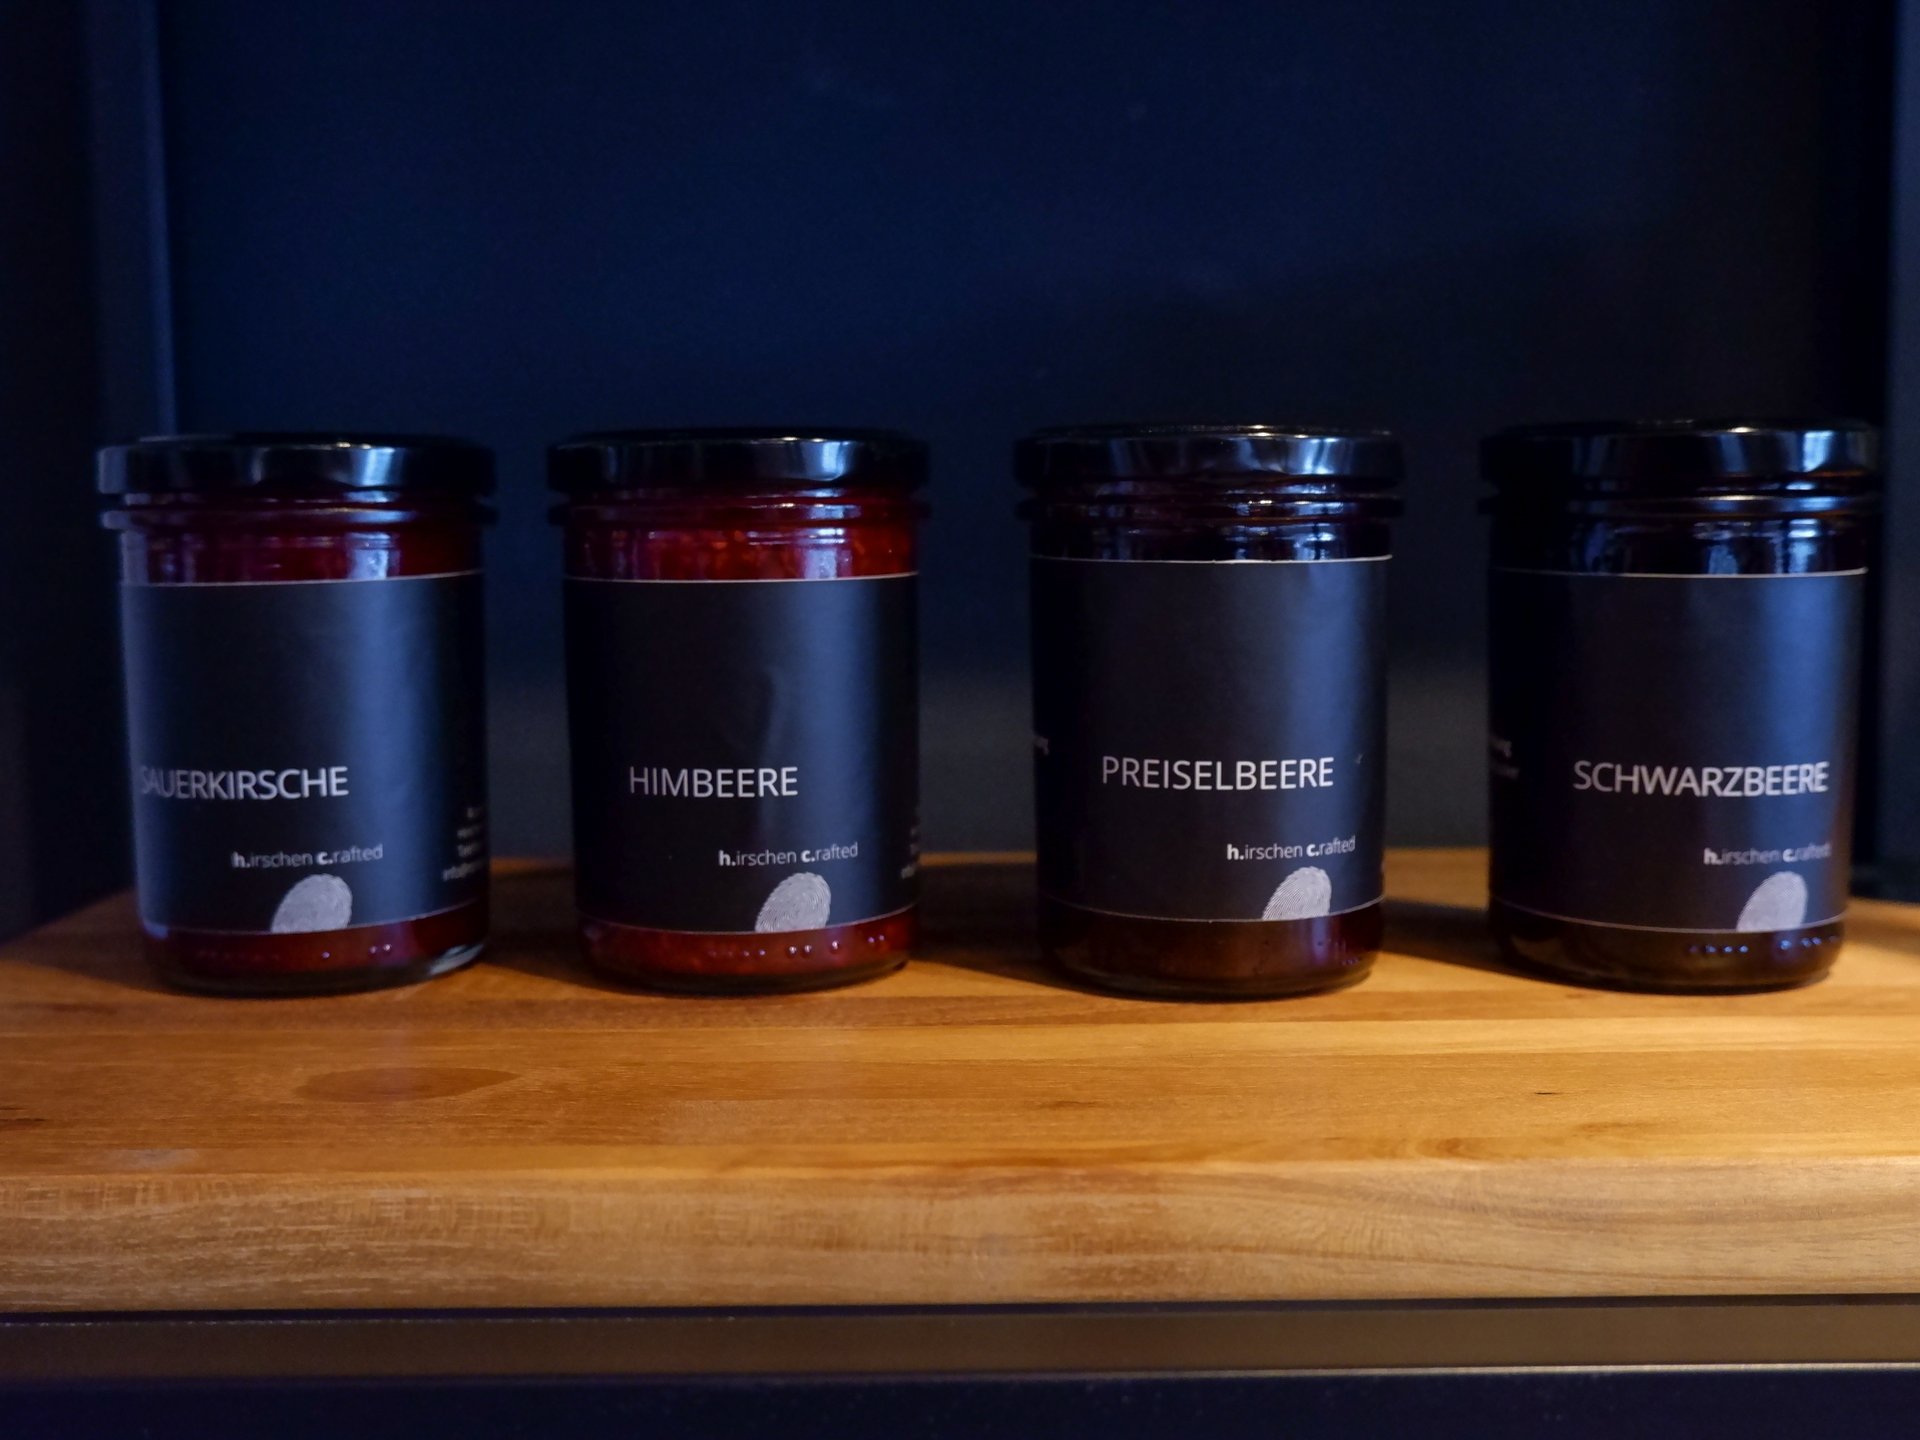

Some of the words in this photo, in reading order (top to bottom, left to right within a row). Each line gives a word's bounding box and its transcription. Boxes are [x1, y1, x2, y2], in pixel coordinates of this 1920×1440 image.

[139, 765, 350, 801] SAUERKIRSCHE
[628, 765, 799, 798] HIMBEERE
[1101, 755, 1335, 791] PREISELBEERE
[1572, 760, 1830, 798] SCHWARZBEERE
[231, 851, 313, 869] h.irschen
[316, 844, 384, 865] c.rafted
[717, 849, 797, 867] h.irschen
[800, 841, 859, 864] c.rafted
[1226, 843, 1303, 861] h.irschen
[1306, 835, 1357, 858] c.rafted
[1703, 847, 1780, 866] h.irschen
